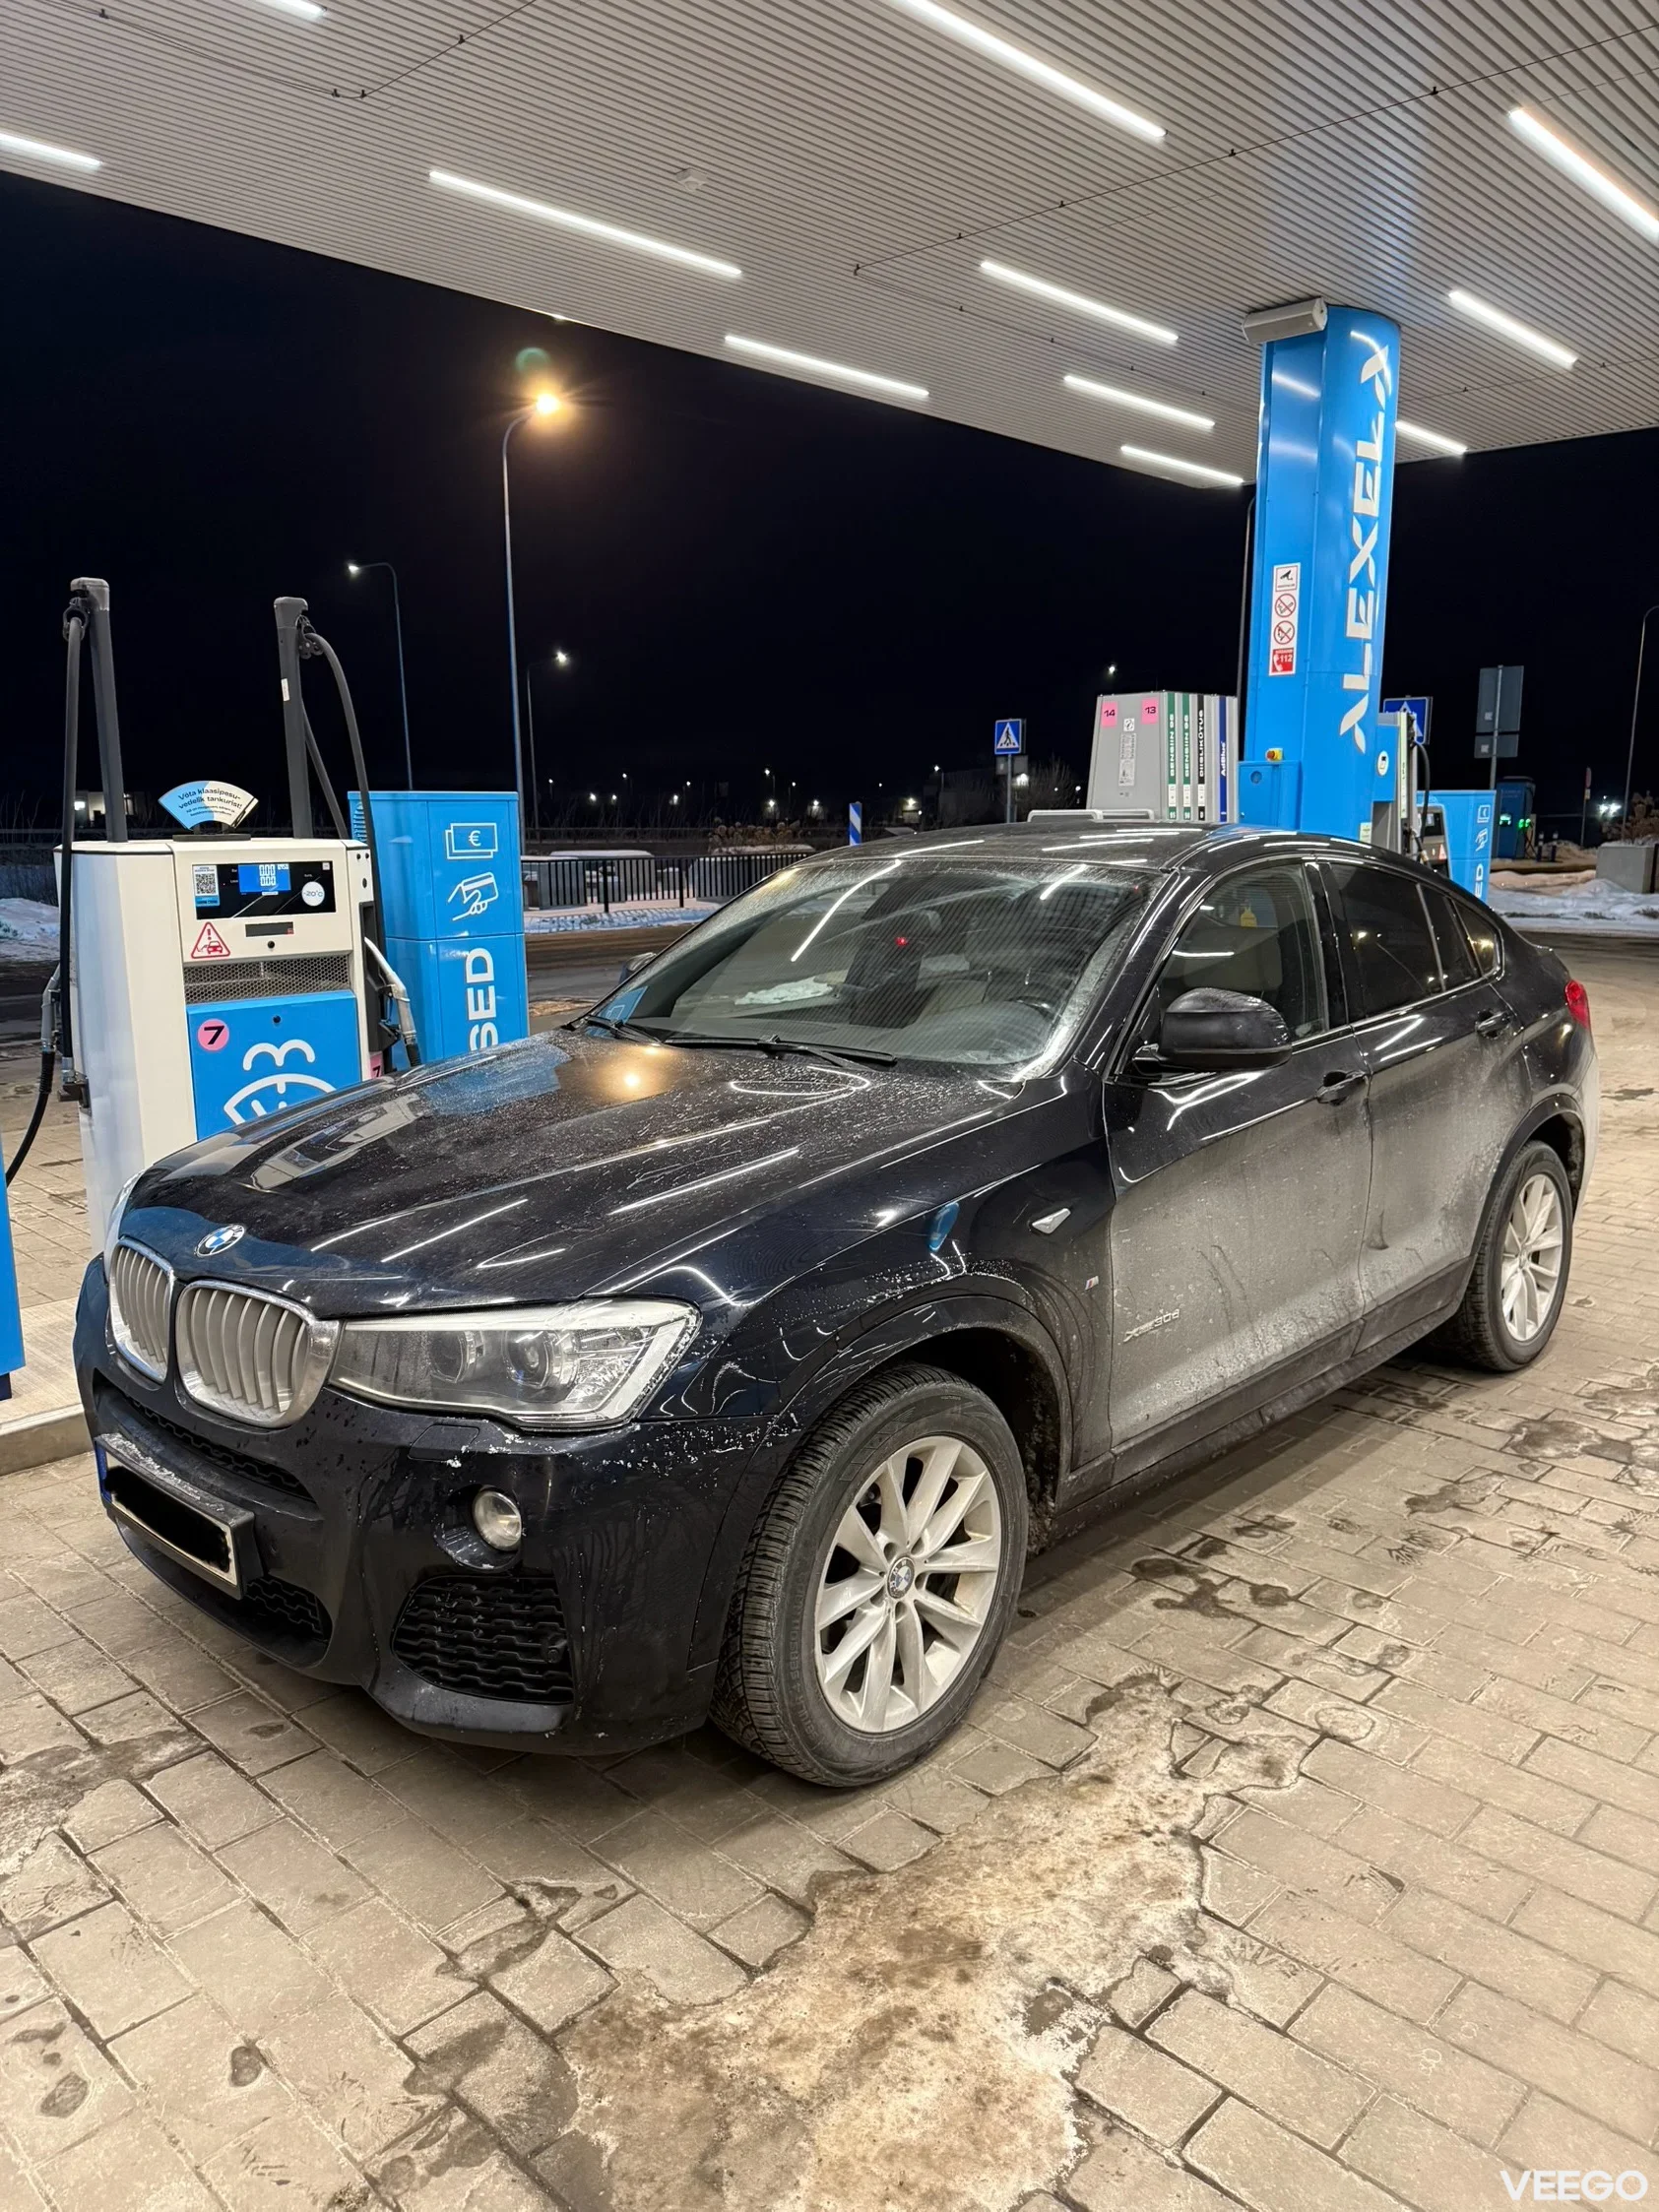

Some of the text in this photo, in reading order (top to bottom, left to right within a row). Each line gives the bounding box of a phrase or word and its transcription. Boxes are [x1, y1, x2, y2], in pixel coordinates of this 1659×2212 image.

[1340, 346, 1390, 754] ALEXELA
[204, 1026, 225, 1044] 7
[372, 1065, 381, 1077] 7
